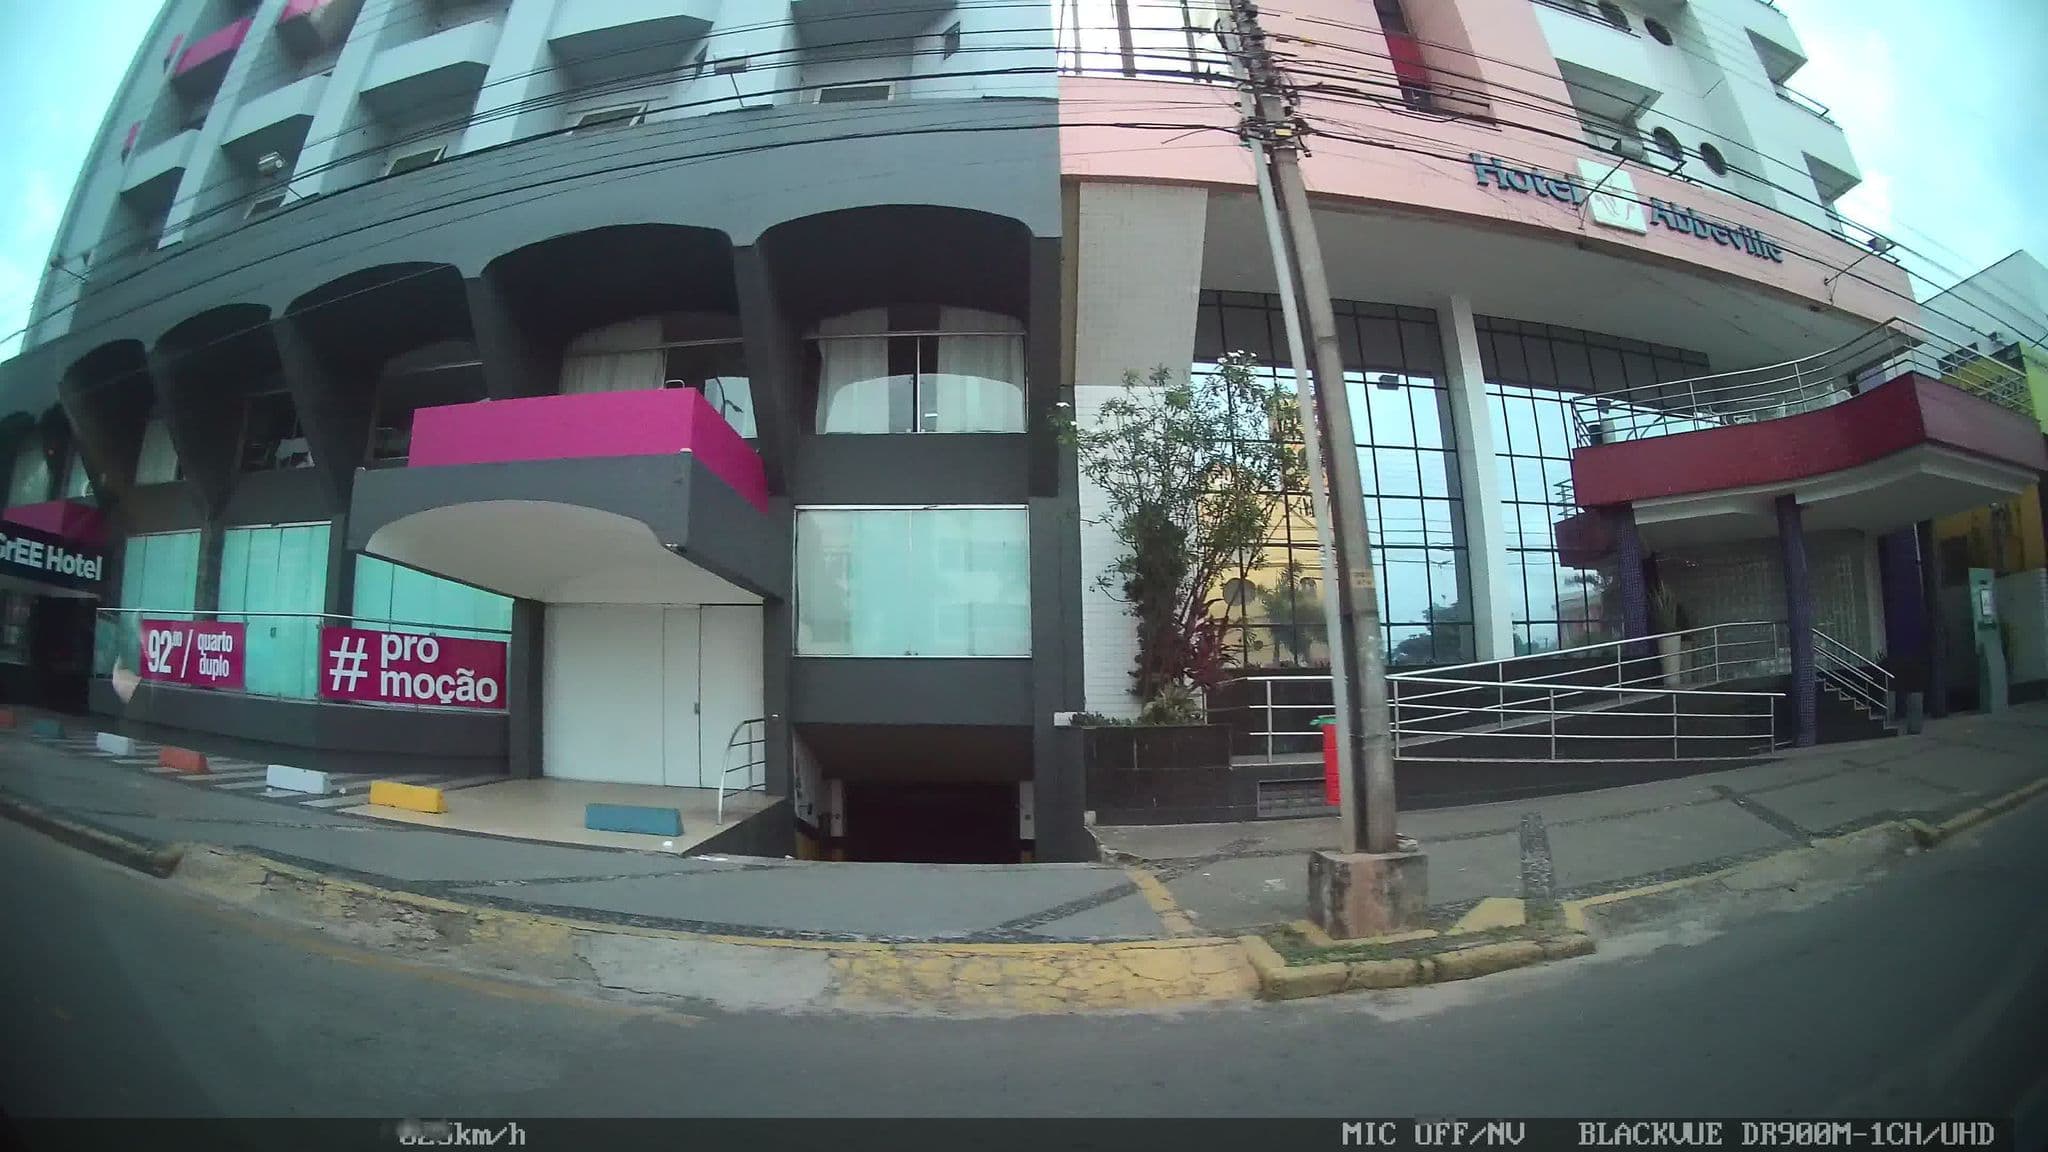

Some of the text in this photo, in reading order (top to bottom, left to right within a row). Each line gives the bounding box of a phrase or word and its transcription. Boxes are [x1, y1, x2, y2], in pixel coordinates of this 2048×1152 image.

[1469, 152, 1784, 263] Hotel Abbeville
[46, 545, 103, 581] Hotel
[197, 630, 233, 656] quarto
[380, 633, 439, 669] pro
[199, 653, 230, 681] duplo
[329, 636, 369, 692] #
[380, 668, 498, 704] moção
